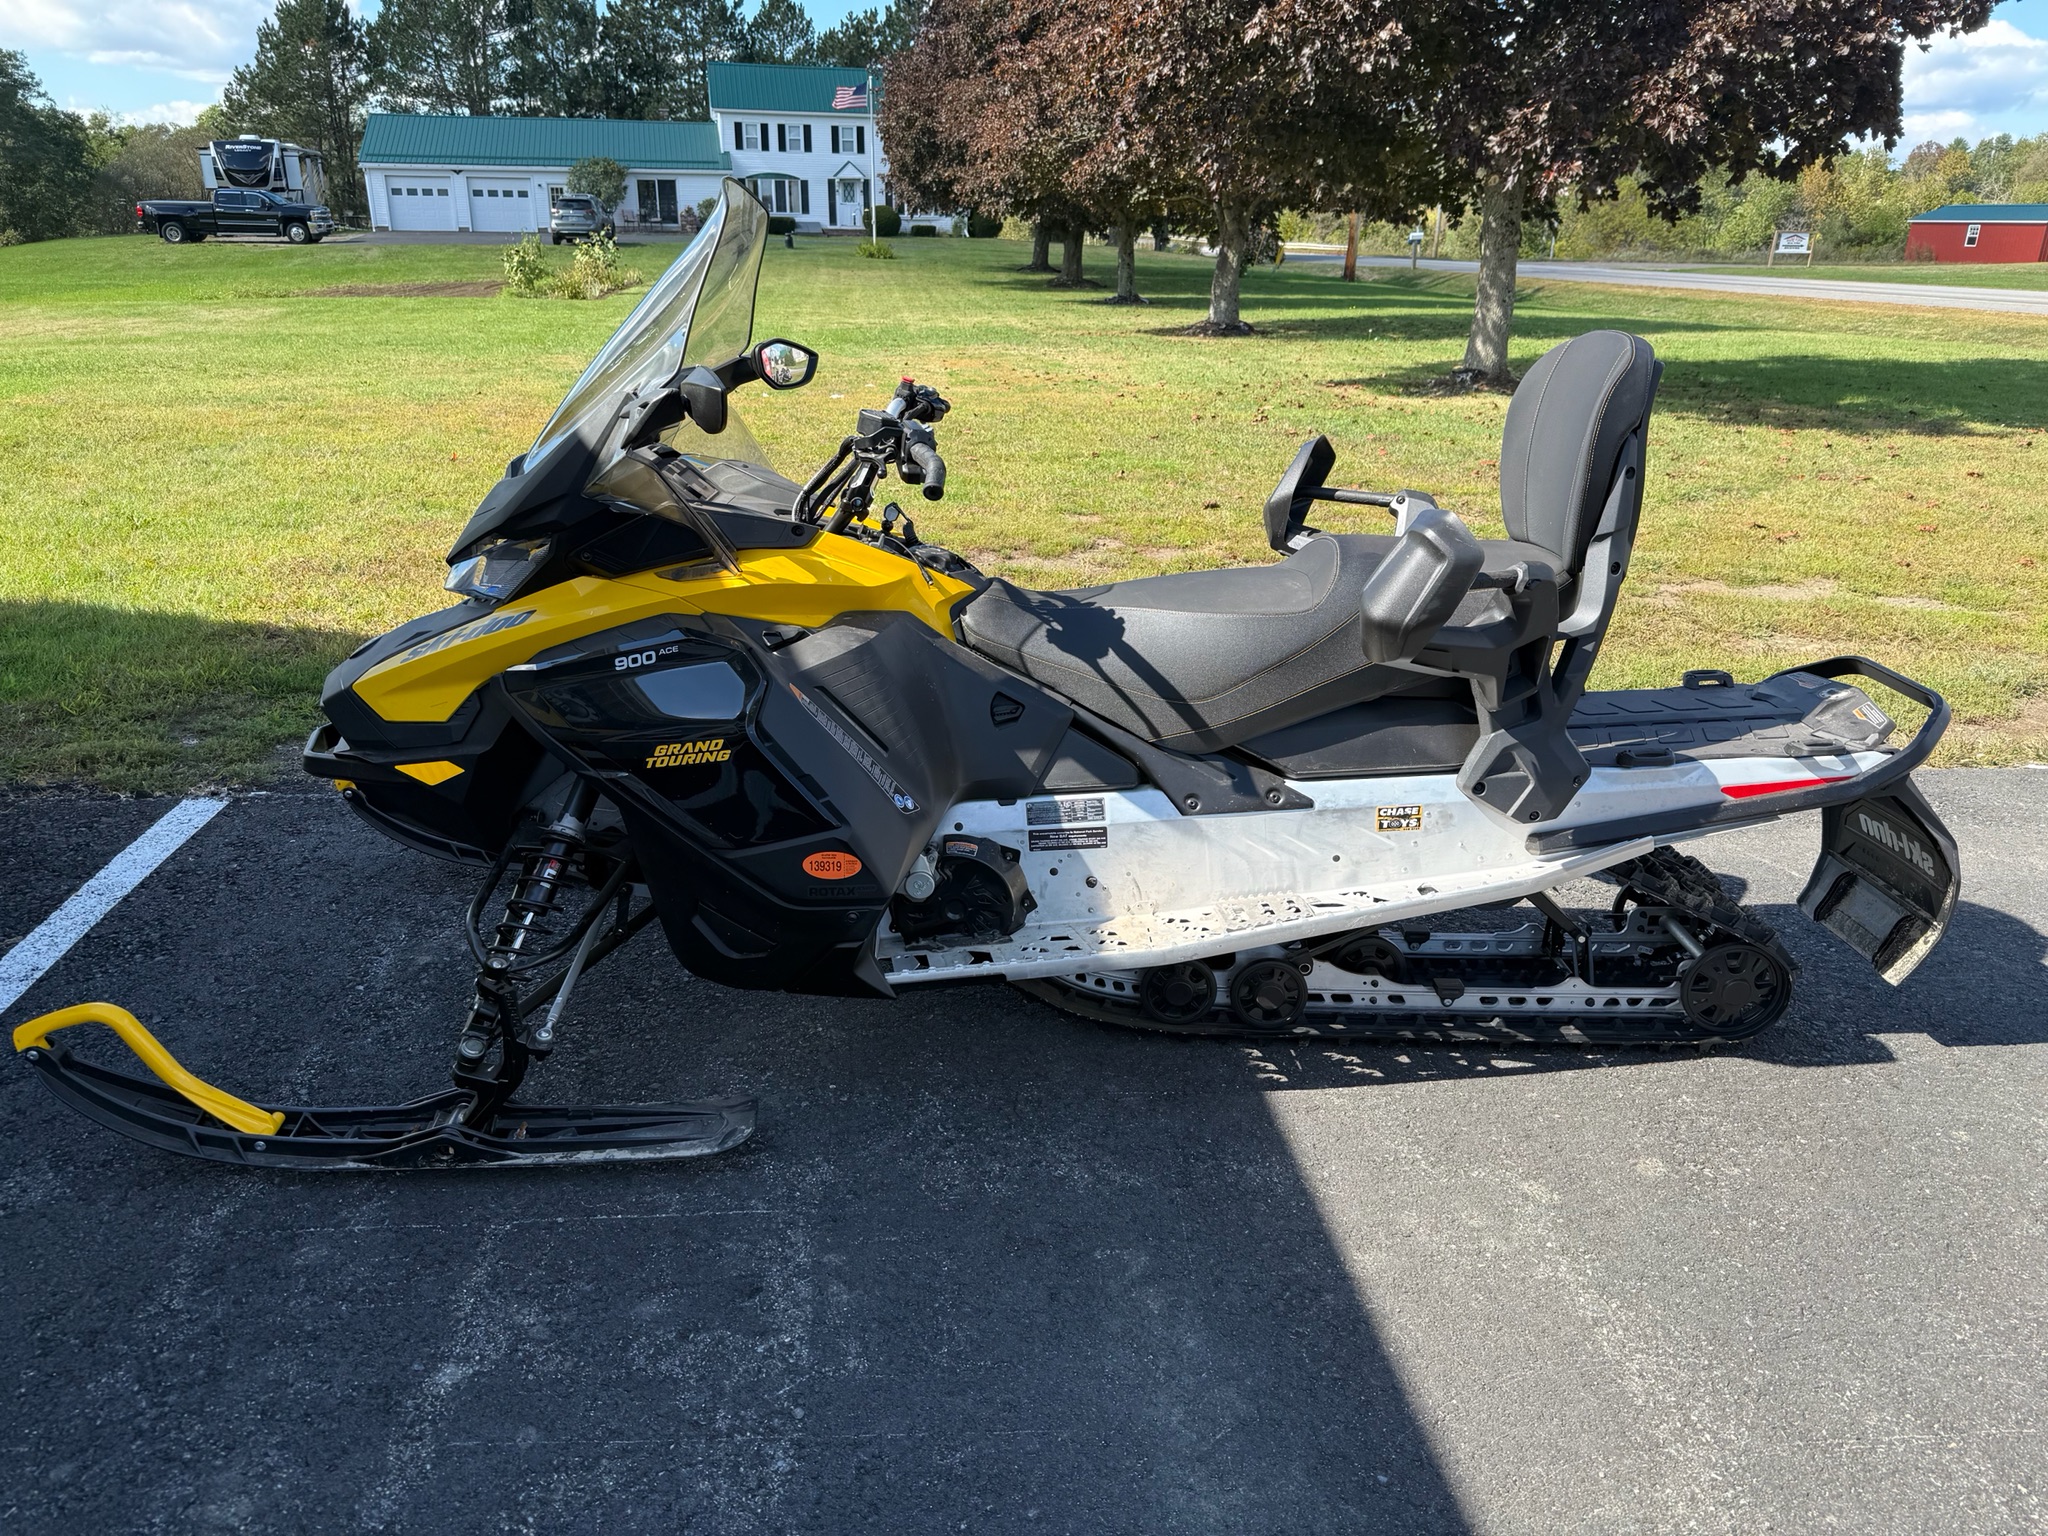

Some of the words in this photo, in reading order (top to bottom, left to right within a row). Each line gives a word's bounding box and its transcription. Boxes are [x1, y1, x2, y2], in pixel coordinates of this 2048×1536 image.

[614, 650, 657, 671] 900
[658, 645, 679, 656] ACE
[653, 738, 725, 757] GRAND
[645, 749, 732, 769] TOURING
[1379, 807, 1419, 816] CHASE
[809, 860, 842, 872] 139319
[808, 886, 856, 897] ROTAX
